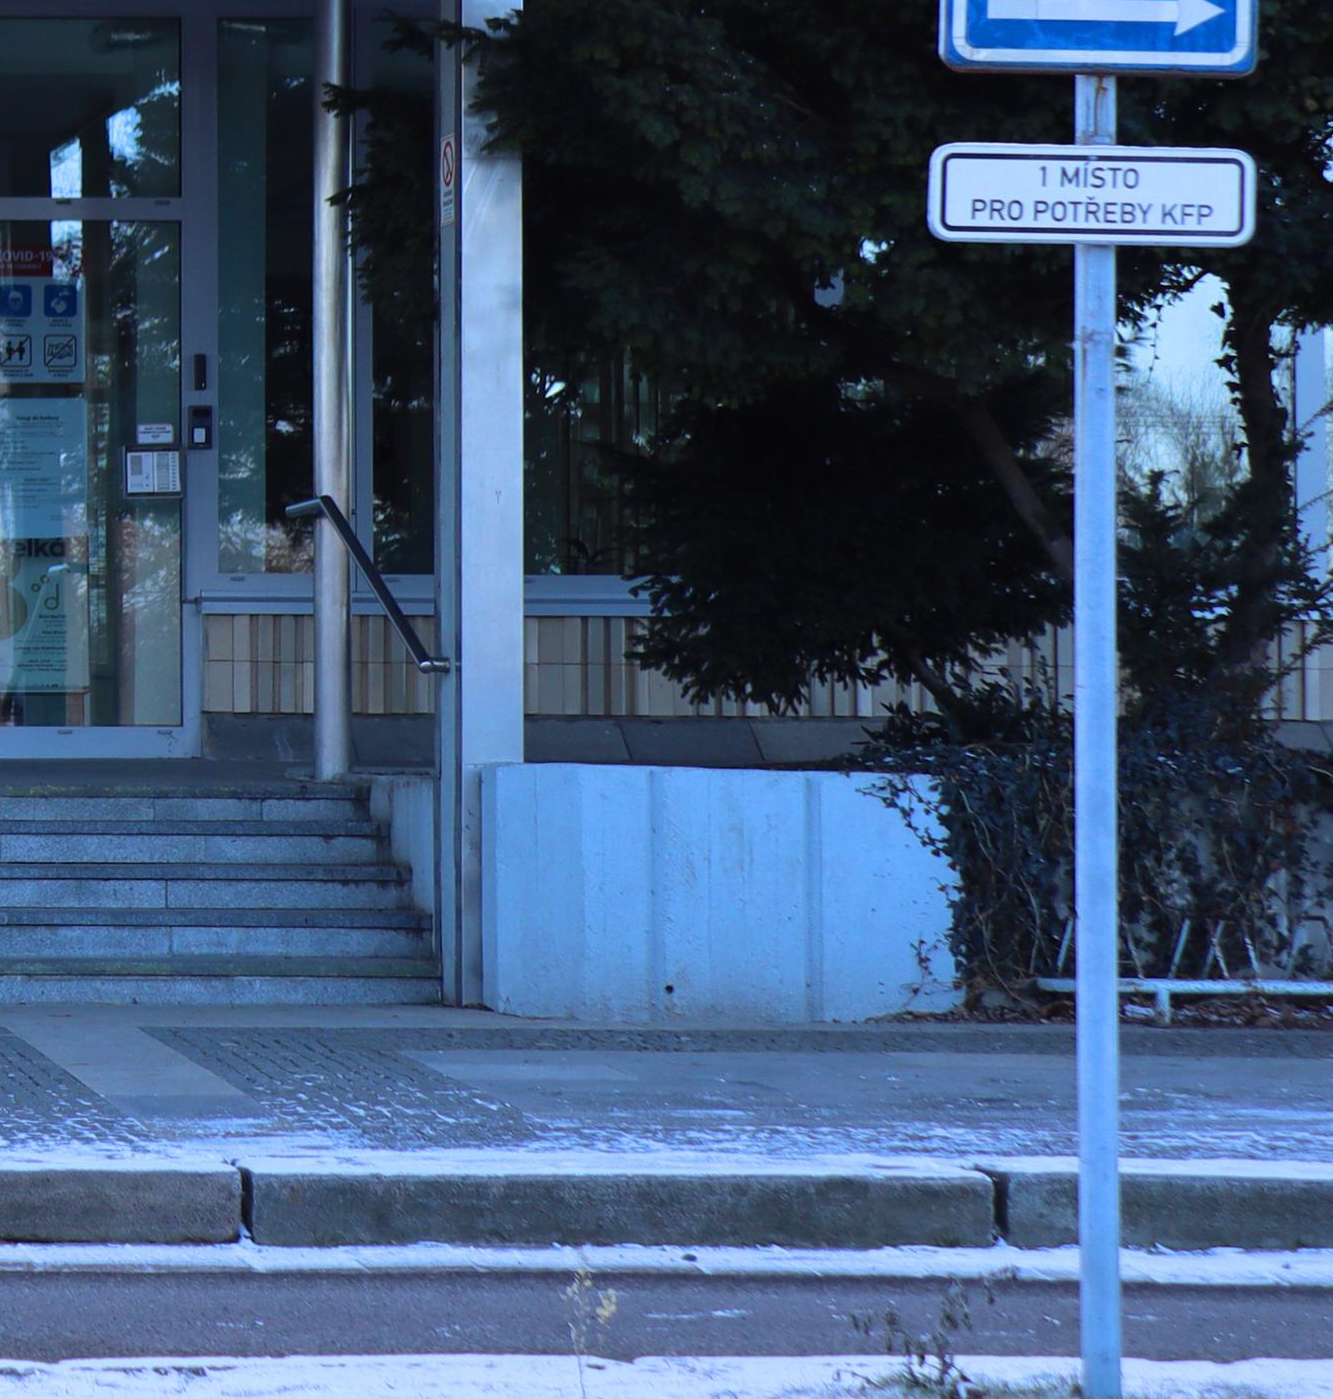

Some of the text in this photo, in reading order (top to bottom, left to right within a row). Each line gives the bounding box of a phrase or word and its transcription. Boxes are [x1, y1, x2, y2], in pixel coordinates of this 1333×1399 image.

[1039, 162, 1141, 190] 1 MÍSTO
[970, 196, 1214, 226] PRO POTŘEBY KFP
